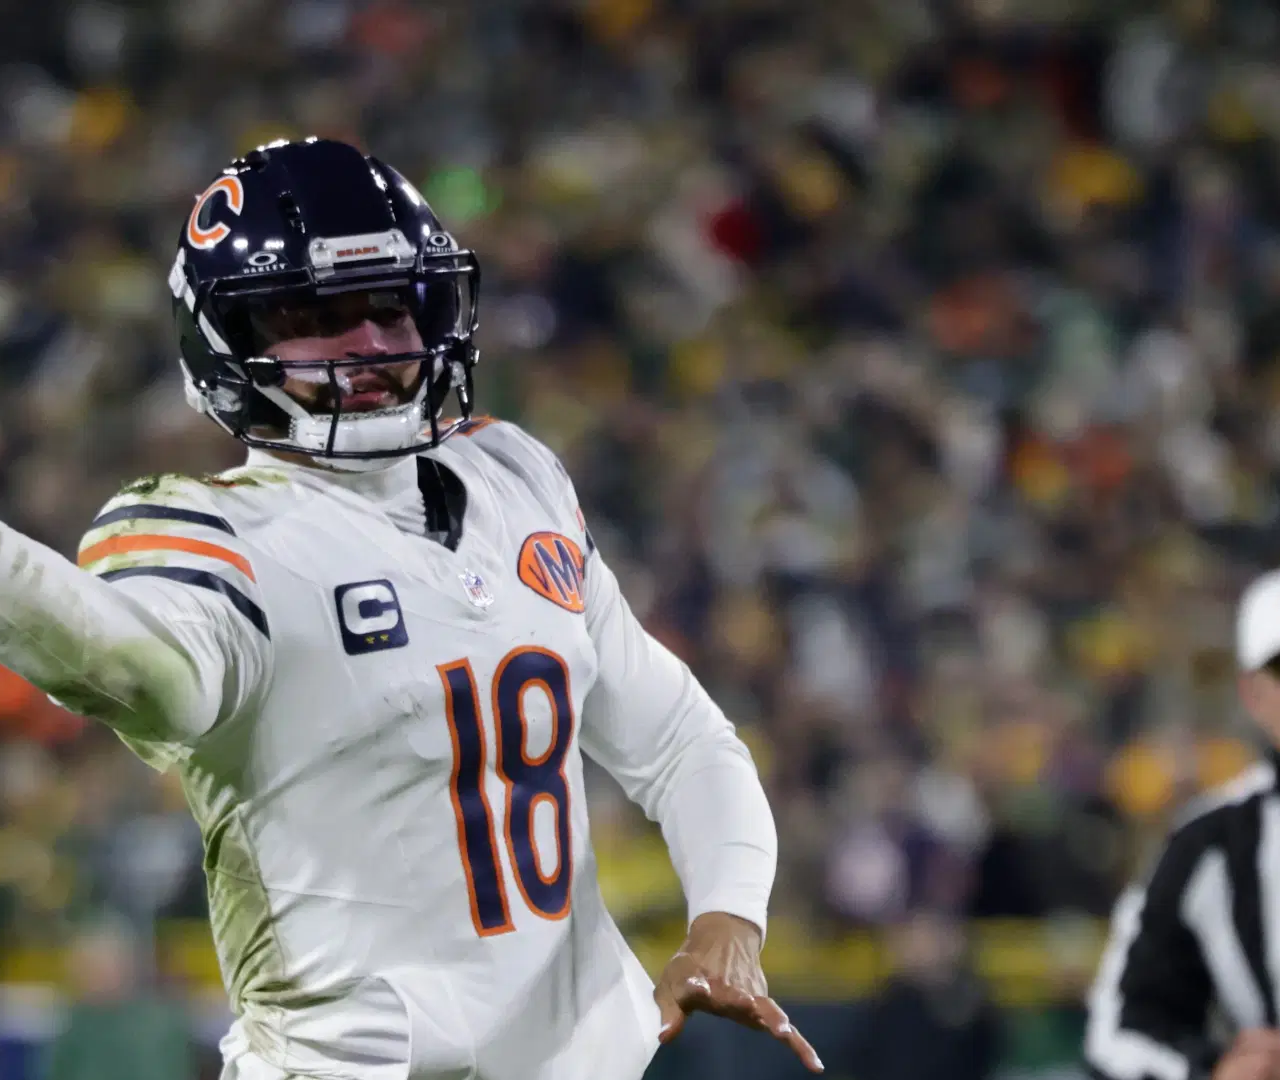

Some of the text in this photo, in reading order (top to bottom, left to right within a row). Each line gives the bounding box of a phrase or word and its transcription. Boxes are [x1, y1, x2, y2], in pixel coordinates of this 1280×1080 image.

[187, 174, 244, 249] C
[243, 263, 287, 274] OAKLEY
[341, 583, 400, 635] C
[436, 645, 575, 938] 18
